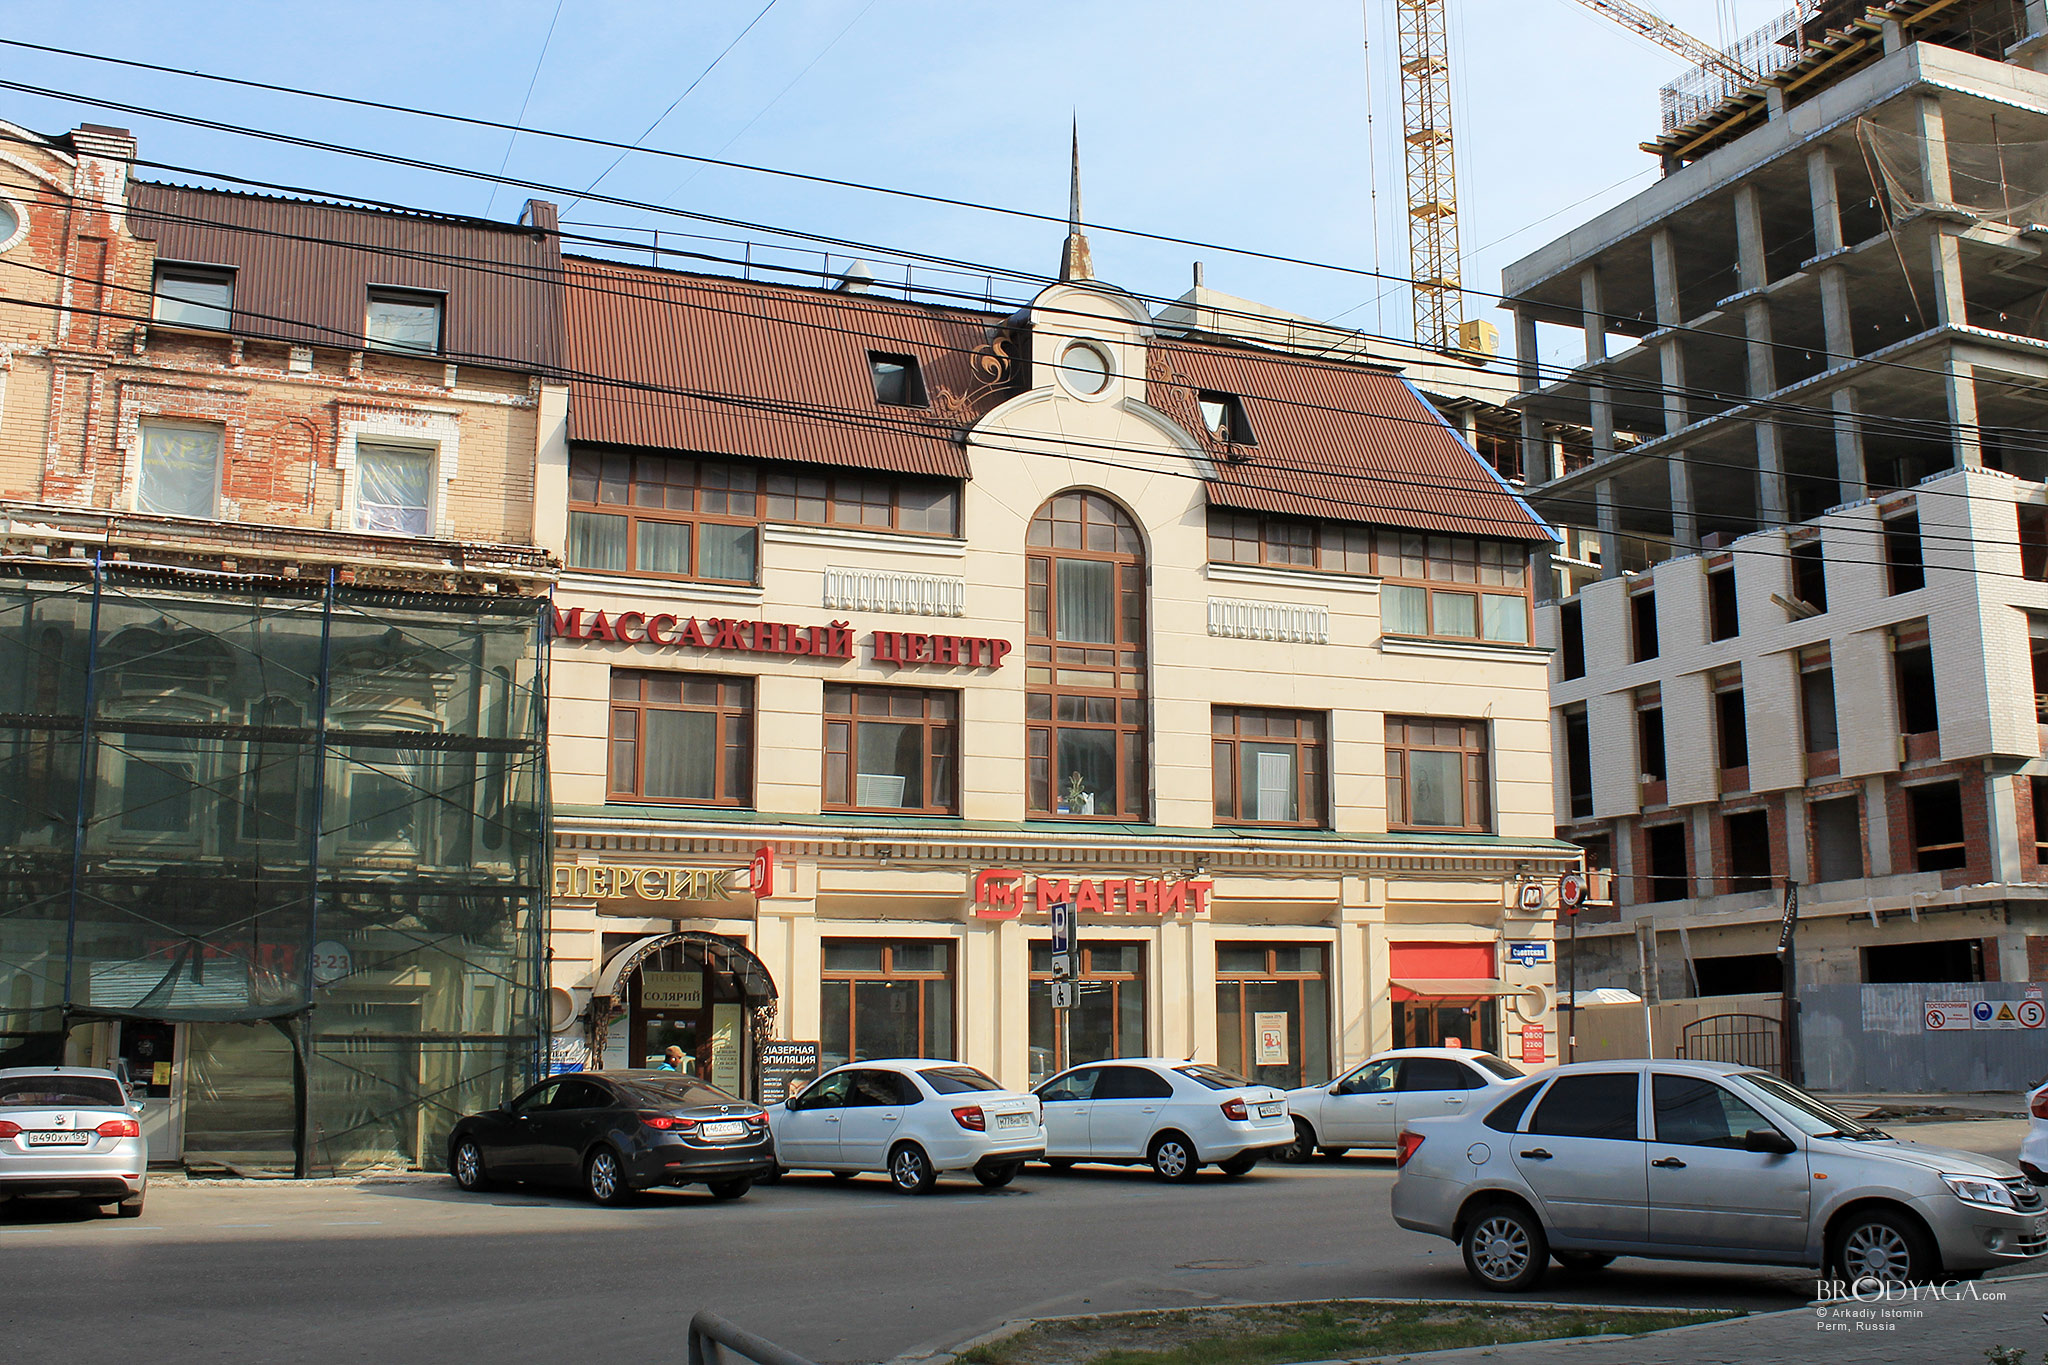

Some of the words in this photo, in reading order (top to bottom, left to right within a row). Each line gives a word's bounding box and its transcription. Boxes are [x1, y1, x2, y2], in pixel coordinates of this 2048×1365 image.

[548, 605, 856, 660] МАССАЖНЫЙ
[870, 630, 1012, 670] ЦЕНТР
[552, 863, 735, 901] ПЕРСИК
[1035, 877, 1213, 913] МАГНИТ
[643, 990, 700, 1002] СОЛЯРИЙ
[2027, 1008, 2037, 1021] 5
[763, 1045, 815, 1055] ЛАЗЕРНАЯ
[762, 1055, 817, 1065] ЭПИЛЯЦИЯ
